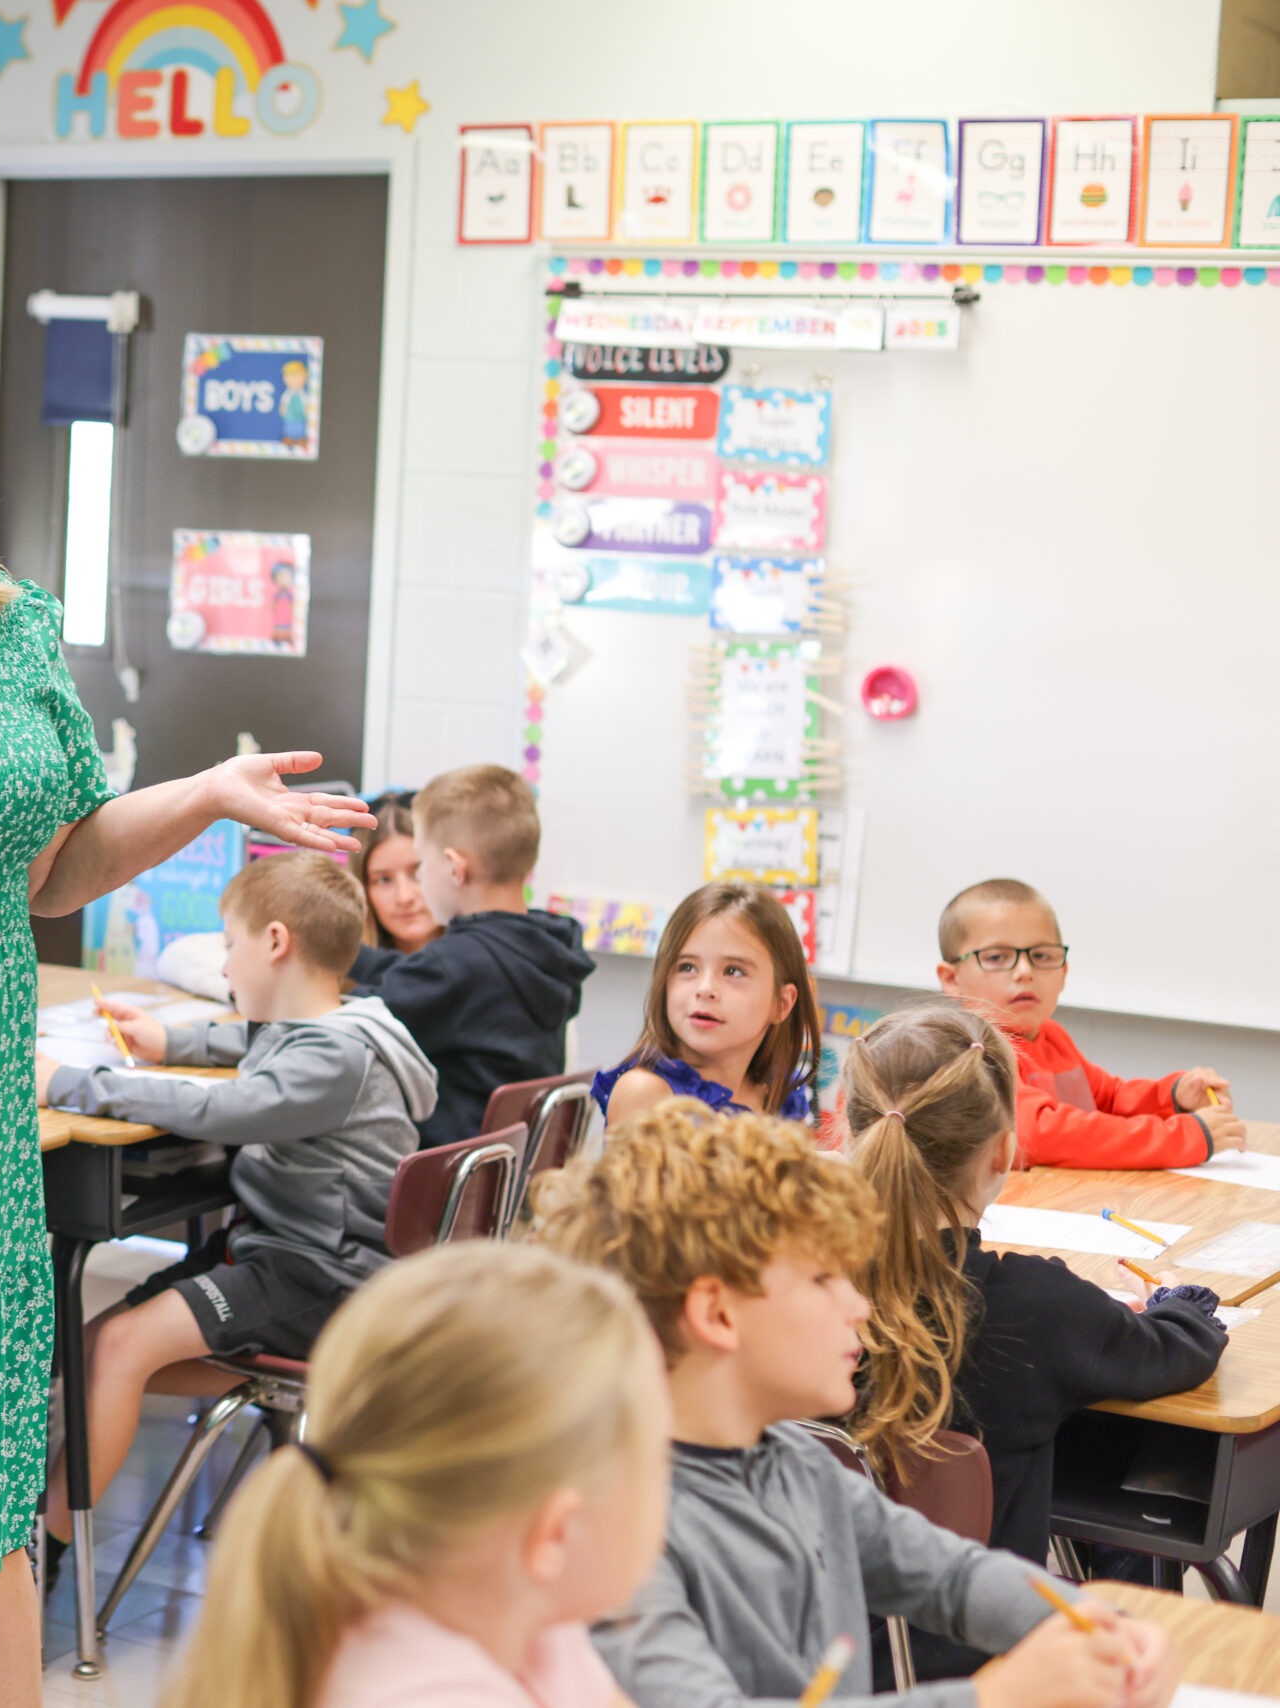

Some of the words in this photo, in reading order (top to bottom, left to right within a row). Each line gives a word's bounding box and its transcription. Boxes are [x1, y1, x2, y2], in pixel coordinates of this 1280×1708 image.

[55, 62, 322, 138] HELLO
[474, 148, 520, 176] Aa
[557, 141, 600, 173] Bb
[639, 142, 680, 174] Cc
[720, 142, 764, 174] Dd
[808, 141, 844, 174] Ee
[978, 139, 1027, 180] Gg
[1073, 140, 1117, 173] Hh
[1179, 137, 1199, 172] Ii
[702, 315, 836, 336] SEPTEMBER
[572, 344, 644, 374] VOICE
[647, 344, 724, 374] LEVELS
[203, 378, 276, 414] BOYS
[620, 395, 698, 430] SILENT
[606, 454, 708, 488] WHISPER
[187, 573, 267, 608] GIRLS
